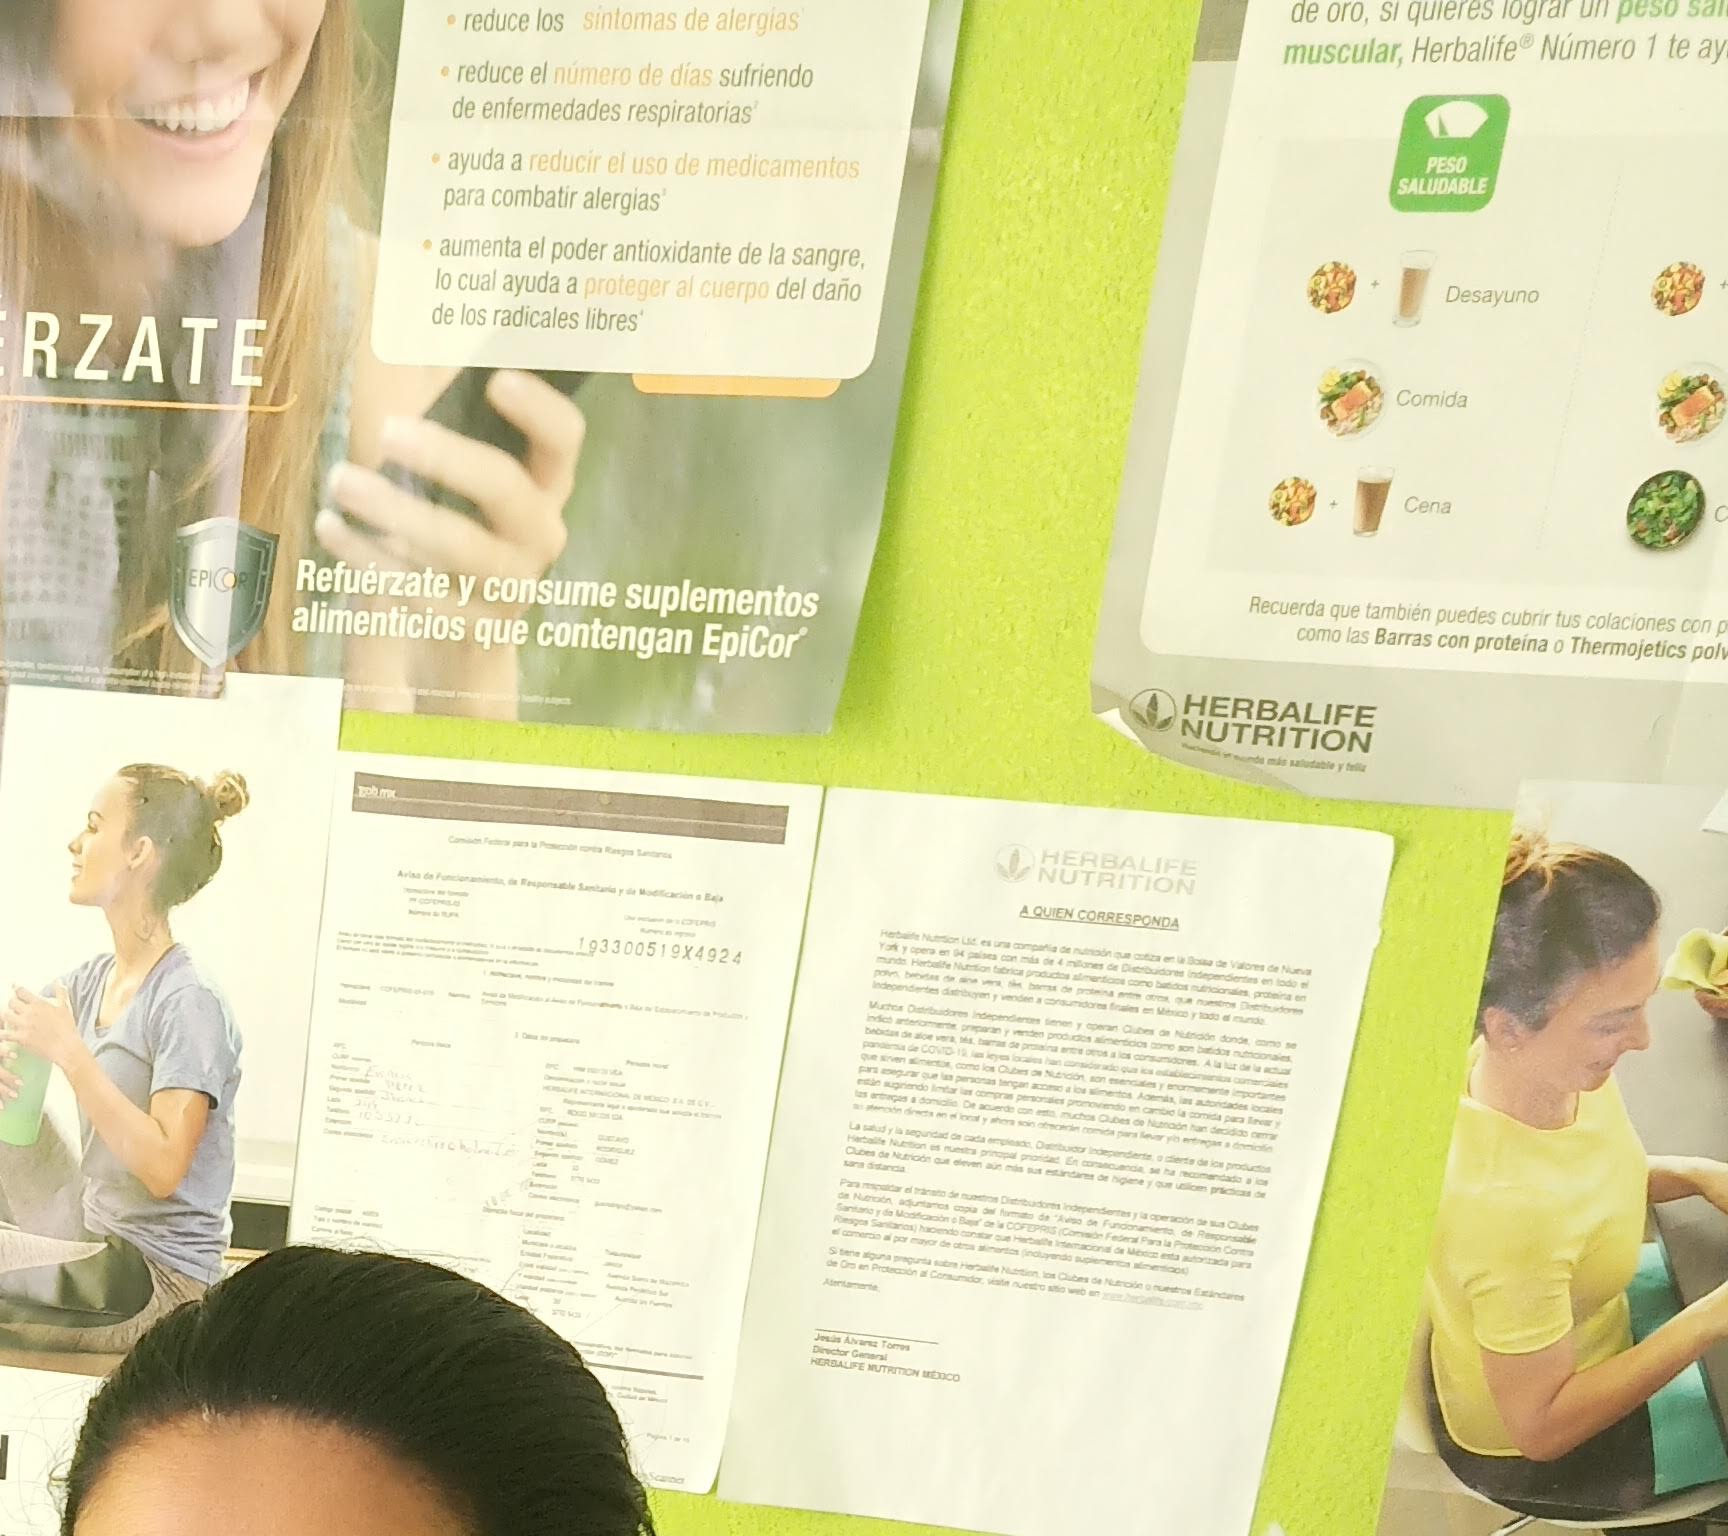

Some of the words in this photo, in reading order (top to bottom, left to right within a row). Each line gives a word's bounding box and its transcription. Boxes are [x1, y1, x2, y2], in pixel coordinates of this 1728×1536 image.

[464, 8, 529, 31] reduce
[536, 8, 564, 32] los
[583, 6, 676, 30] síntomas
[684, 7, 709, 31] de
[1283, 38, 1404, 68] muscular,
[1540, 33, 1635, 60] Número
[1648, 33, 1656, 59] 1
[1668, 33, 1690, 59] te
[1697, 38, 1728, 64] ay
[457, 61, 523, 83] reduce
[530, 60, 547, 84] el
[554, 61, 631, 85] número
[638, 62, 663, 86] de
[670, 62, 712, 86] días
[719, 63, 813, 87] sufriendo
[452, 96, 475, 118] de
[482, 97, 620, 121] enfermedades
[448, 148, 504, 174] ayuda
[510, 152, 522, 171] a
[529, 149, 601, 172] reducir
[607, 151, 625, 173] el
[631, 156, 667, 175] uso
[674, 152, 699, 175] de
[706, 154, 859, 178] medicamentos
[1426, 156, 1468, 175] PESO
[443, 187, 484, 210] para
[491, 185, 577, 208] combatir
[1397, 177, 1488, 196] SALUDABLE
[439, 236, 521, 257] aumenta
[528, 236, 545, 258] el
[551, 238, 607, 263] poder
[613, 240, 731, 263] antioxidante
[738, 241, 762, 264] de
[768, 242, 785, 265] la
[791, 247, 864, 271] sangre,
[435, 267, 451, 290] lo
[457, 269, 496, 291] cual
[502, 271, 559, 296] ayuda
[566, 276, 577, 294] a
[584, 272, 670, 301] proteger
[675, 275, 693, 297] al
[699, 280, 768, 303] cuerpo
[775, 277, 806, 299] del
[812, 278, 861, 301] daño
[1445, 285, 1539, 306] Desayuno
[431, 302, 454, 325] de
[460, 303, 486, 325] los
[493, 305, 578, 329] radicales
[1396, 389, 1467, 407] Comida
[1404, 495, 1451, 514] Cena
[296, 559, 450, 599] Refuérzate
[457, 574, 476, 607] y
[483, 575, 617, 608] consume
[625, 579, 820, 618] suplementos
[1249, 595, 1324, 616] Recuerda
[1329, 603, 1360, 620] que
[1365, 602, 1431, 621] también
[1435, 606, 1496, 625] puedes
[1501, 610, 1551, 626] cubrir
[1555, 610, 1581, 628] tus
[1585, 612, 1675, 631] colaciones
[1680, 618, 1711, 633] con
[291, 600, 465, 642] alimenticios
[474, 616, 529, 650] que
[536, 618, 693, 660] contengan
[1296, 627, 1341, 642] como
[1345, 626, 1369, 644] las
[1374, 627, 1432, 647] Barras
[1437, 634, 1469, 648] con
[1473, 634, 1548, 652] proteína
[1553, 639, 1564, 653] o
[1571, 636, 1686, 659] Thermojetics
[1183, 693, 1378, 728] HERBALIFE
[1180, 718, 1373, 753] NUTRITION
[1041, 850, 1196, 877] HERBALIFE
[1038, 867, 1194, 894] NUTRITION
[1019, 904, 1028, 918] A
[1032, 905, 1073, 920] QUIEN
[1077, 909, 1178, 927] CORRESPONDA
